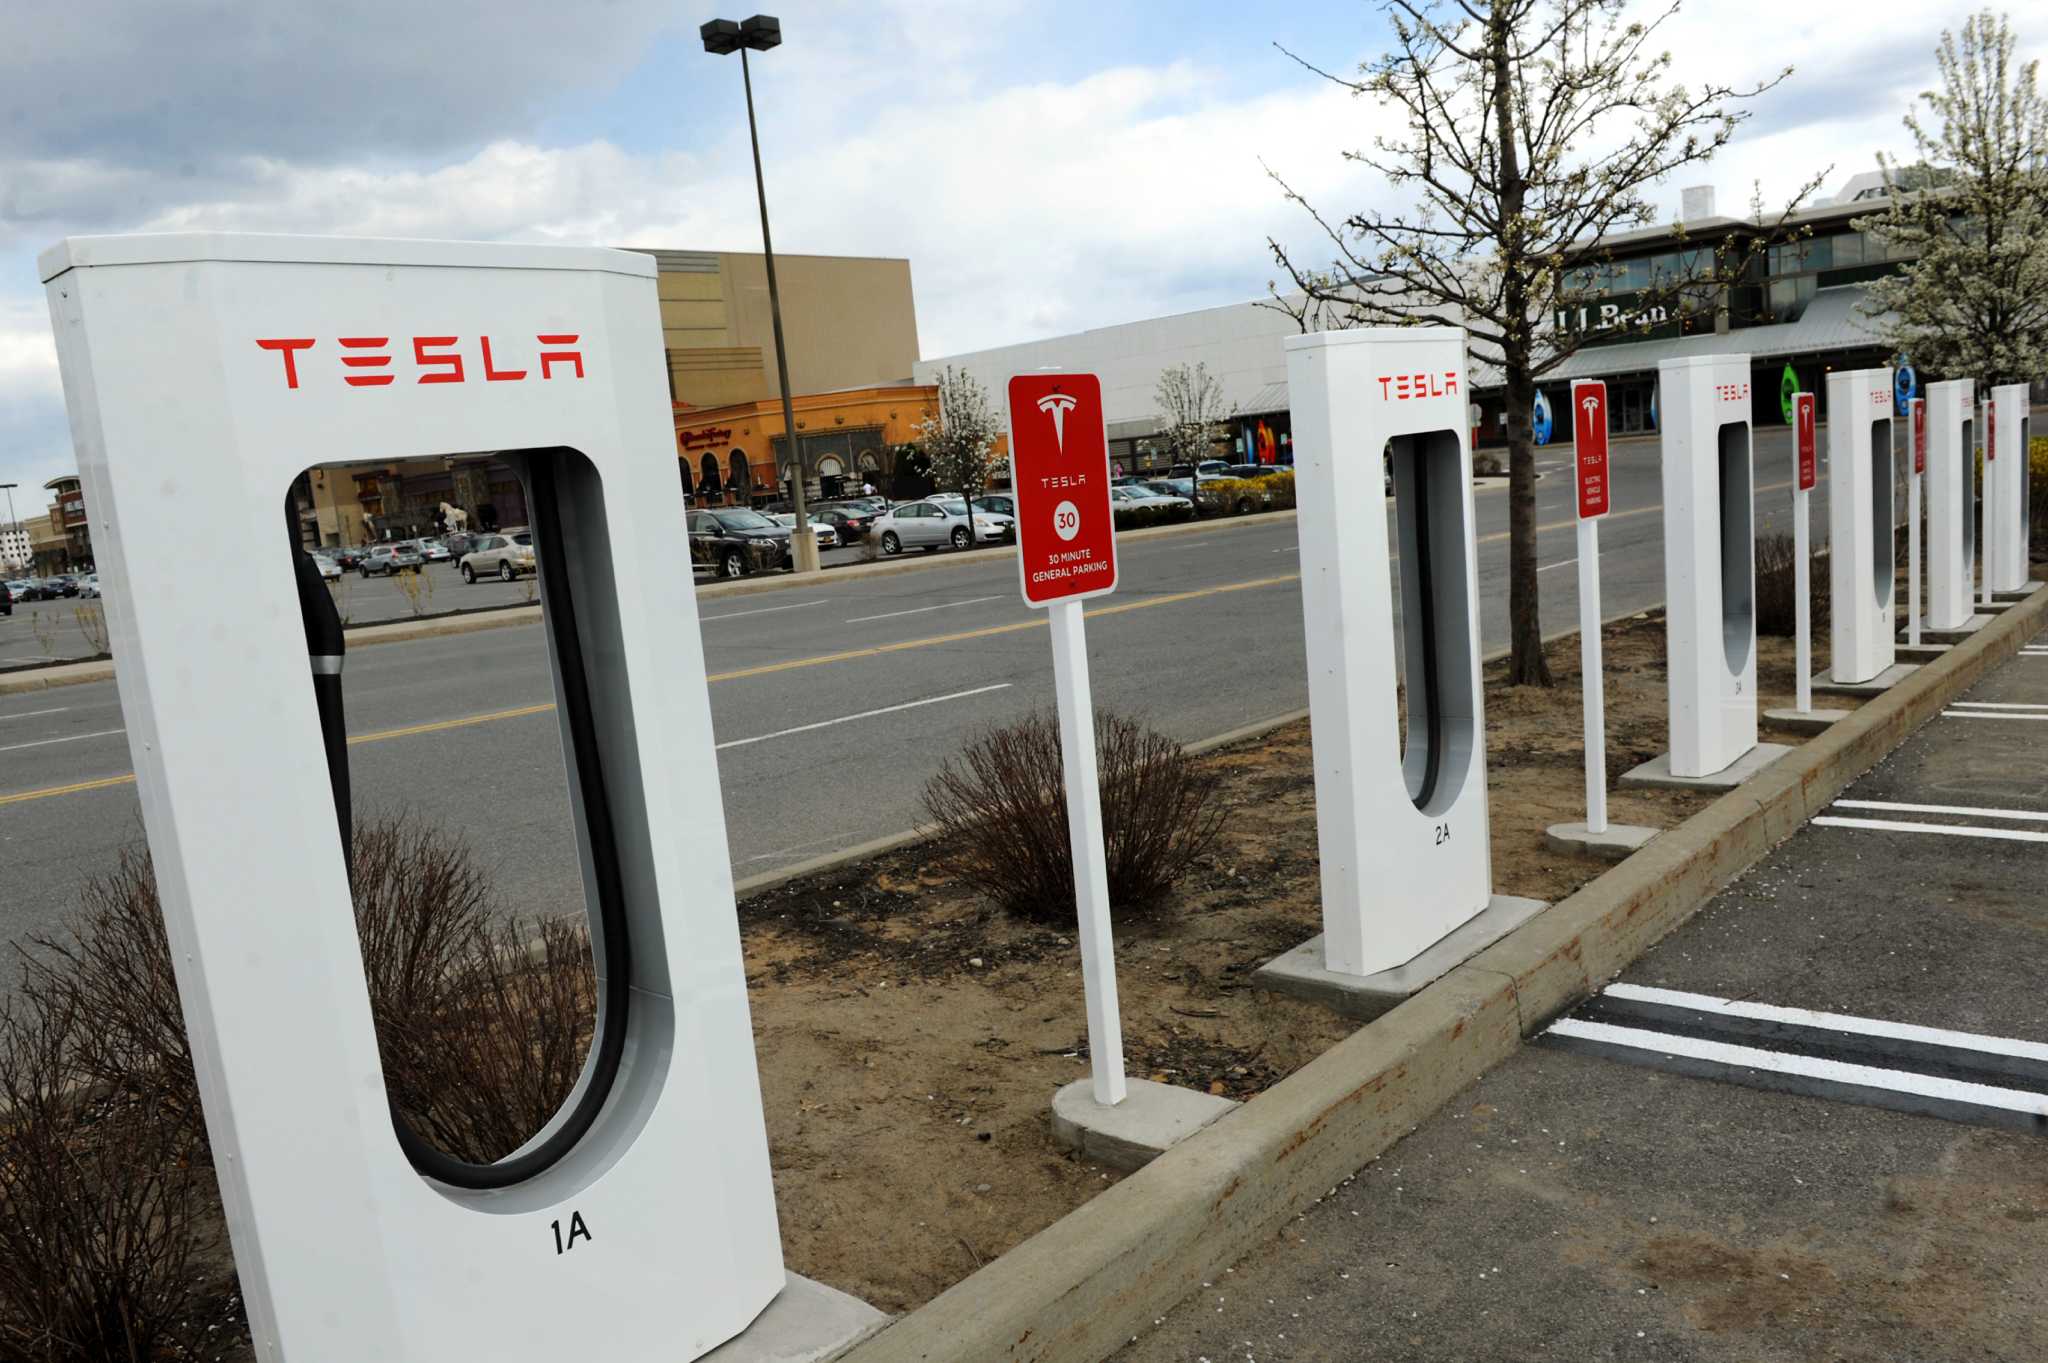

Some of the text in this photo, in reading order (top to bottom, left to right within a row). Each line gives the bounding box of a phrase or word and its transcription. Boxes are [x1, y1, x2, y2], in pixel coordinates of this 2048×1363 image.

[256, 335, 585, 389] TESLA
[1378, 372, 1457, 401] TESLA
[1041, 474, 1086, 489] TESLA
[1058, 511, 1076, 529] 30
[1048, 548, 1092, 565] 30 MINUTE
[1032, 560, 1108, 583] GENERAL PARKING
[1435, 822, 1451, 846] 2A
[551, 1210, 592, 1255] 1A
